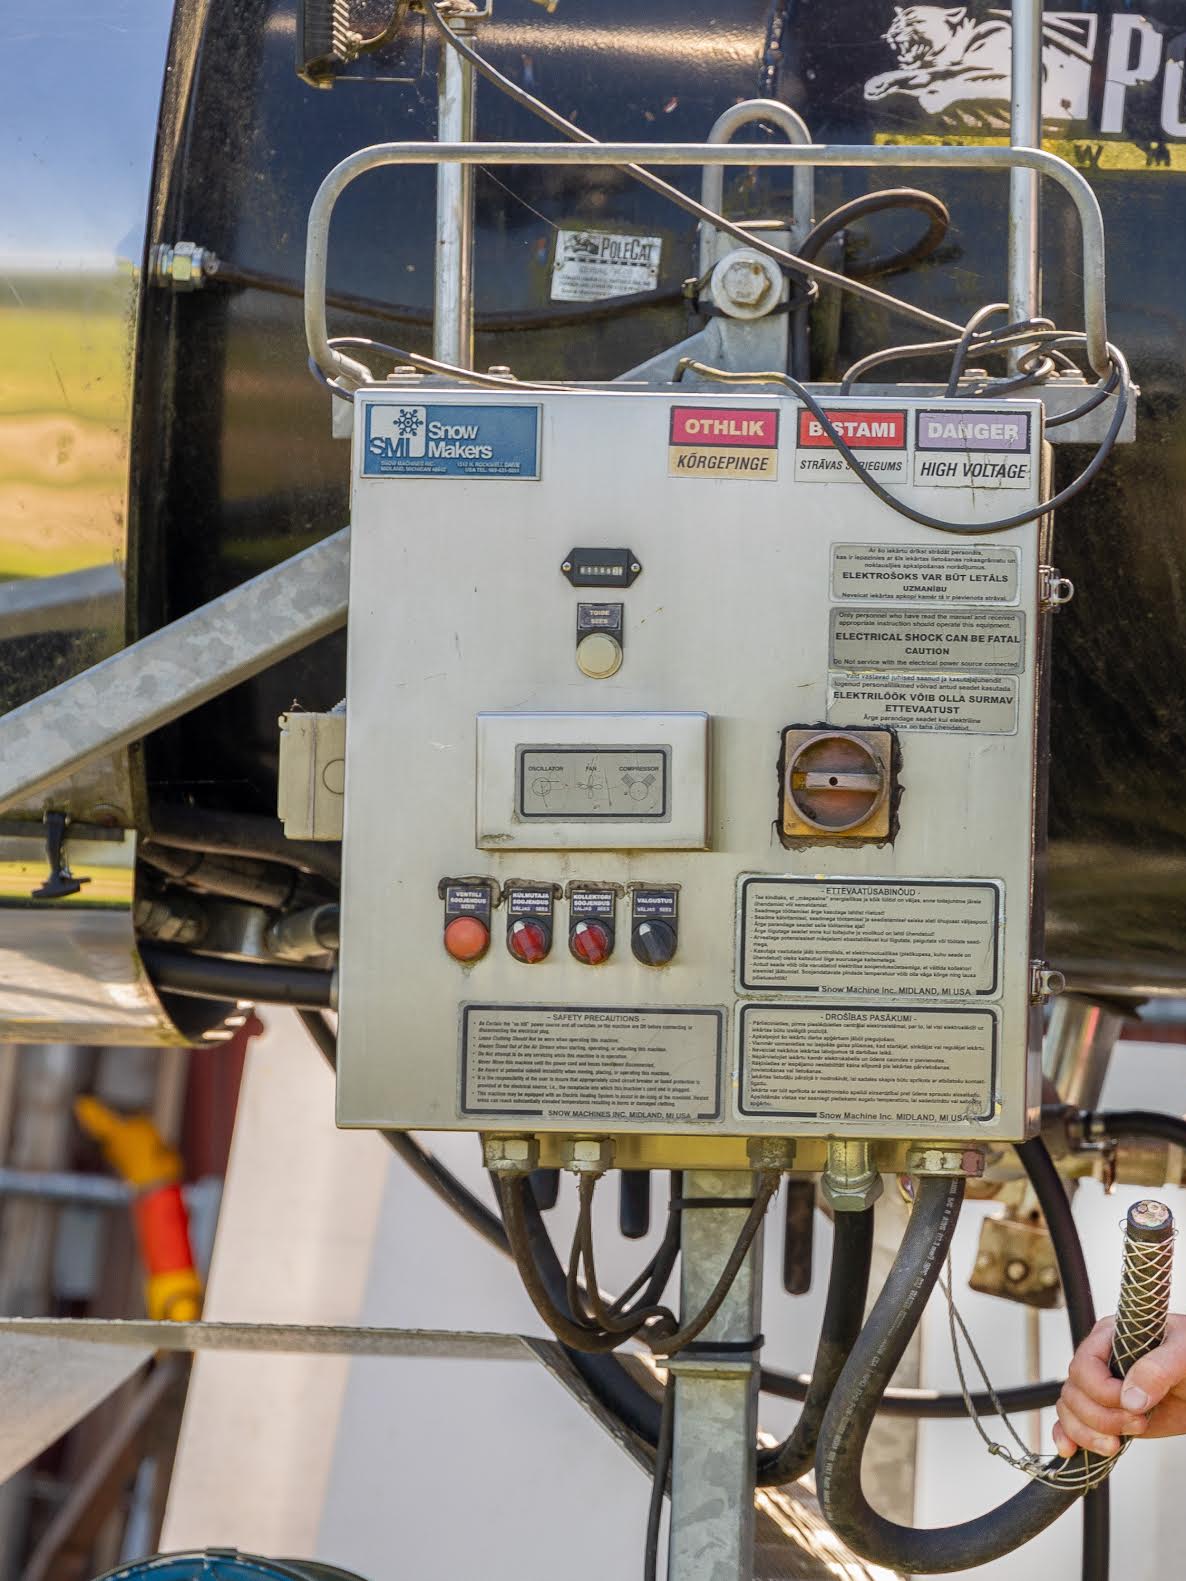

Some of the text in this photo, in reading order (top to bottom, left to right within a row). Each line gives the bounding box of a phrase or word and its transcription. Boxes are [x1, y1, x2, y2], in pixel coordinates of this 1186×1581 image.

[428, 421, 479, 440] Snow
[684, 419, 764, 436] OTHLIK
[809, 420, 896, 437] BSTAMI
[928, 422, 1019, 440] DANGER
[370, 436, 410, 458] SMI
[428, 442, 493, 459] Makers
[677, 453, 769, 471] KÕRGEPINGE
[800, 459, 843, 470] STRĀVAS
[920, 462, 1028, 479] HIGH VOLTAGE
[842, 571, 918, 580] ELEKTROŠOKS
[969, 573, 1008, 582] LETĀLS
[835, 632, 1021, 643] ELECTRICAL SHOCK CAN BE FATAL
[833, 690, 1014, 704] ELEKTRILÖÖK VÕIB OLLA SURMAV
[885, 704, 960, 714] ETTEVAATUST
[826, 887, 916, 895] ETTEVAATUSABINÕUD
[846, 986, 880, 994] Machine
[898, 987, 940, 995] MIDLAND,
[584, 1014, 640, 1022] PRECAUTIONS
[825, 1012, 868, 1021] DROŠĪBAS
[572, 1110, 611, 1118] MACHINES
[612, 1111, 627, 1119] INC.
[628, 1111, 664, 1119] MIDLAND,
[675, 1112, 691, 1120] USA
[819, 1111, 842, 1119] Snow
[950, 1114, 968, 1122] USA
